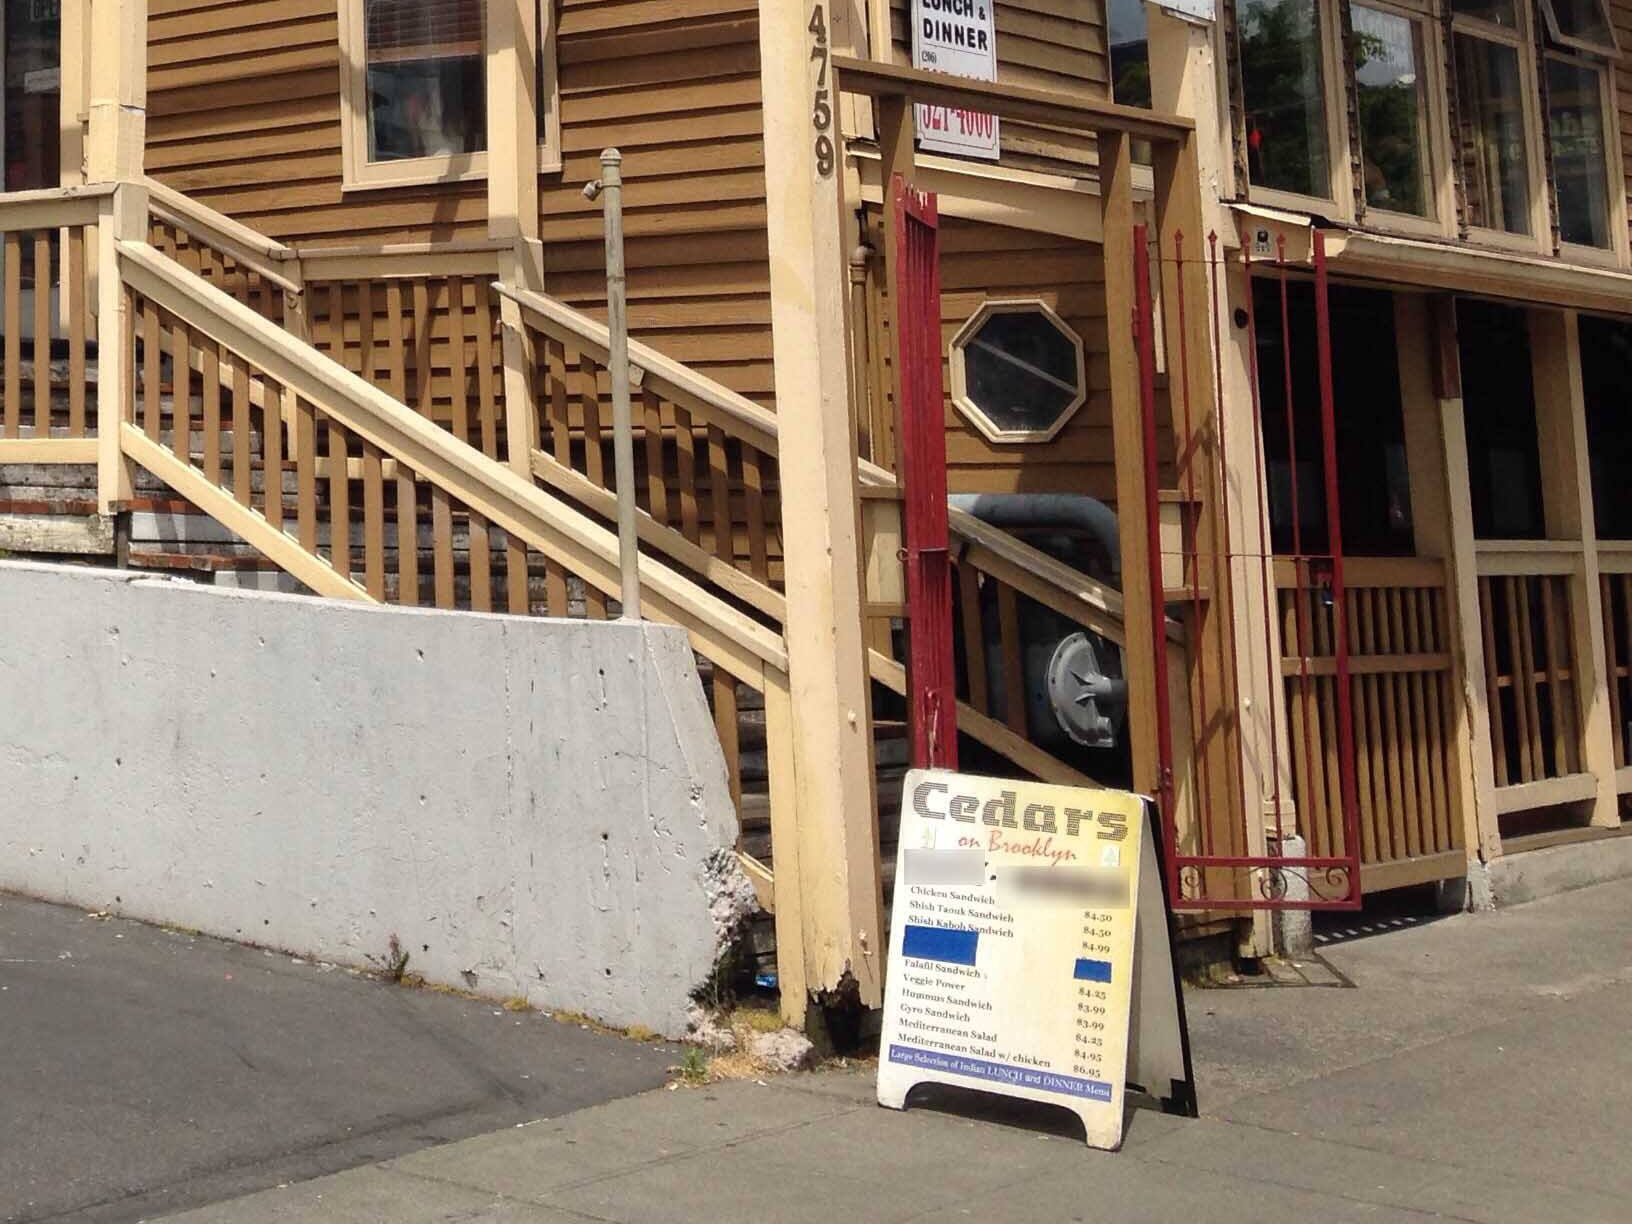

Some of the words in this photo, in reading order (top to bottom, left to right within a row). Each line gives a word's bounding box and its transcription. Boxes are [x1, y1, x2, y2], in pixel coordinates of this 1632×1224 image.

[978, 6, 986, 21] &
[923, 18, 988, 51] DINNER
[808, 4, 834, 177] 4759
[913, 781, 1128, 842] Cedars
[957, 836, 980, 848] on
[988, 830, 1077, 866] Brooklyn
[910, 886, 948, 899] Chicken
[950, 891, 995, 905] Sandwich
[909, 901, 935, 912] Shish
[968, 909, 1014, 923] Sandwich
[908, 915, 933, 926] Shish
[968, 923, 1014, 938] Sandwich
[903, 973, 933, 986] Veggie
[935, 979, 966, 991] Power
[935, 964, 981, 979] Sandwich
[900, 1003, 923, 1015] Gyro
[925, 1007, 970, 1022] Sandwich
[946, 995, 993, 1011] Sandwich
[899, 1018, 968, 1037] Mediterranean
[970, 1030, 997, 1042] Salad
[897, 1033, 968, 1053] Mediterranean
[969, 1044, 996, 1058] Salad
[1012, 1054, 1051, 1068] chicken
[987, 1065, 1023, 1081] LUNCH
[1043, 1076, 1083, 1092] DINNER
